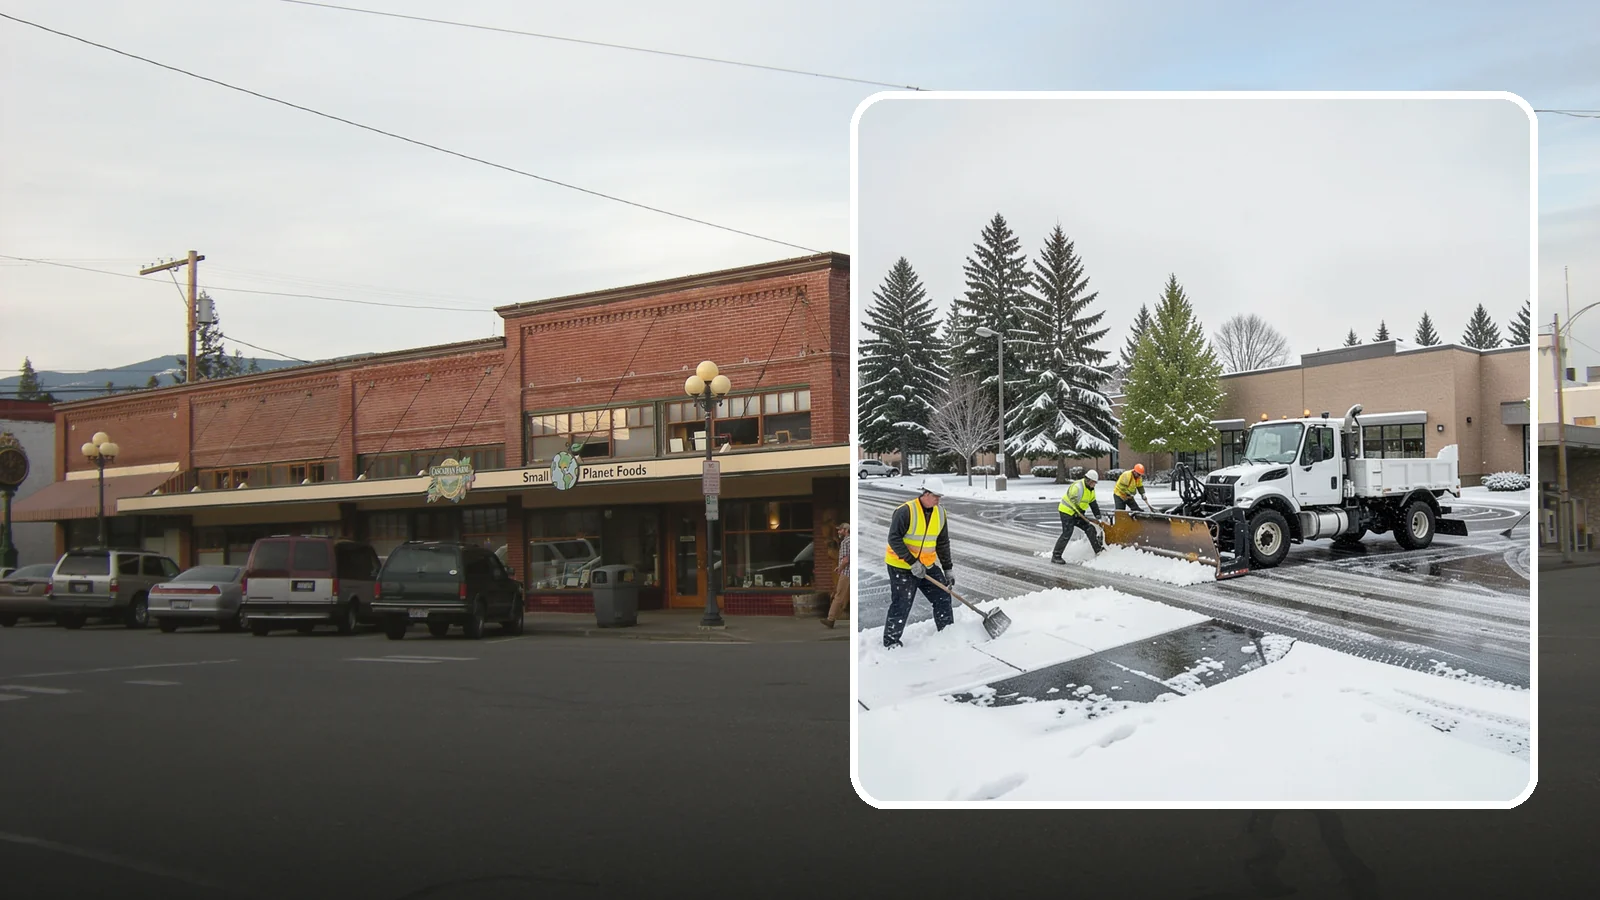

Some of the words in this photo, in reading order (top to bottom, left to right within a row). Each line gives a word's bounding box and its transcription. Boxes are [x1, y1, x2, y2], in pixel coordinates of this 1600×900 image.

[523, 471, 549, 483] Small
[583, 468, 614, 479] Planet
[616, 465, 647, 477] Foods
